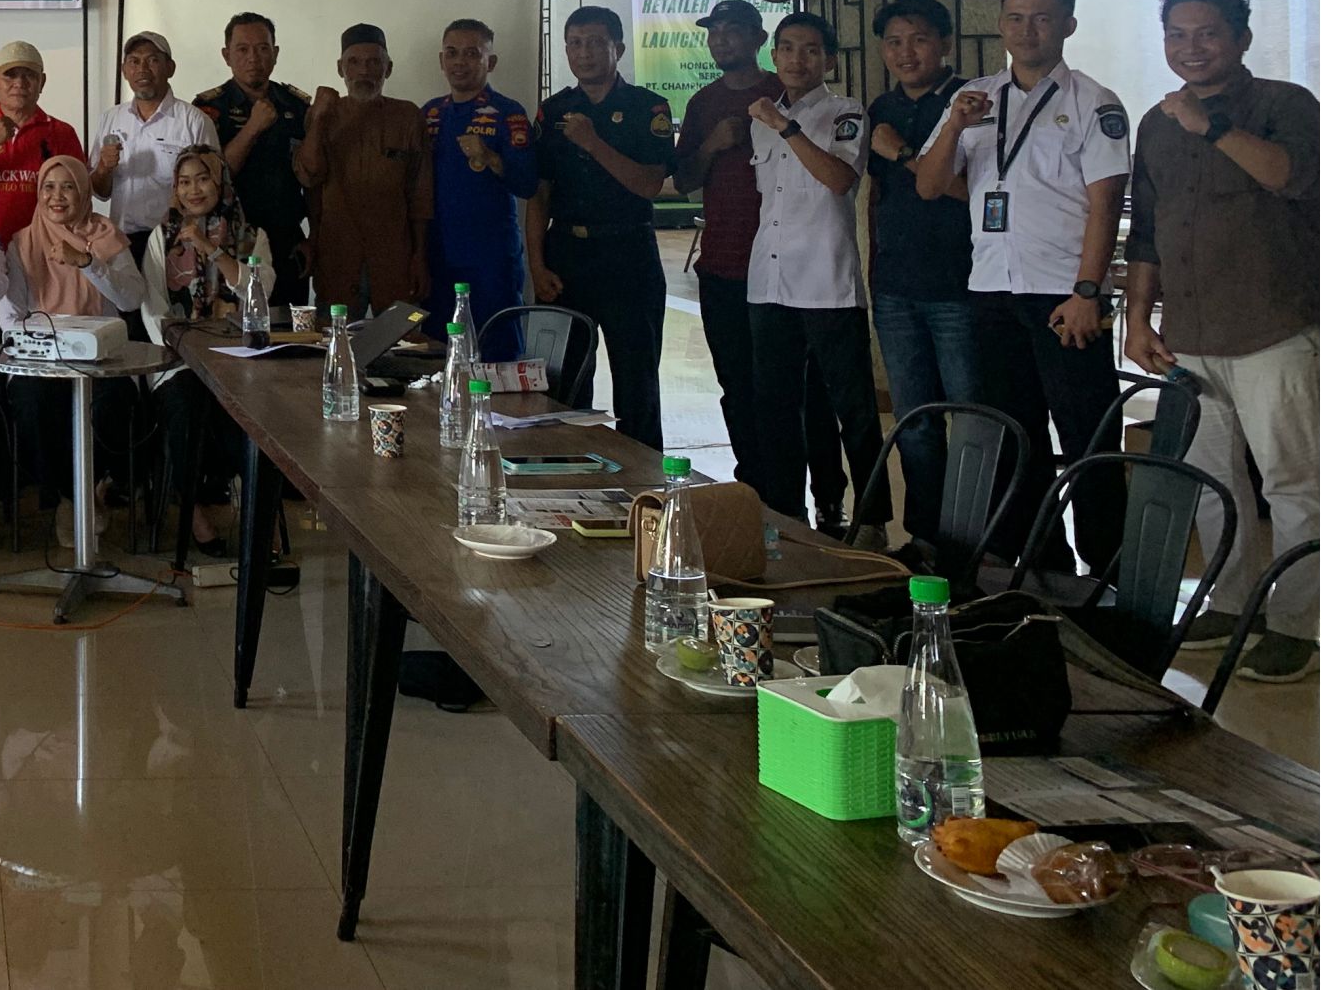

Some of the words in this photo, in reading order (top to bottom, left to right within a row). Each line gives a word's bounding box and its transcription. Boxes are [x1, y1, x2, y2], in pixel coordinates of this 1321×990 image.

[641, 32, 708, 48] LAUNCHI
[680, 62, 719, 70] HONGK
[699, 72, 722, 80] BERS
[646, 82, 659, 90] PT.
[466, 125, 496, 136] POLRI
